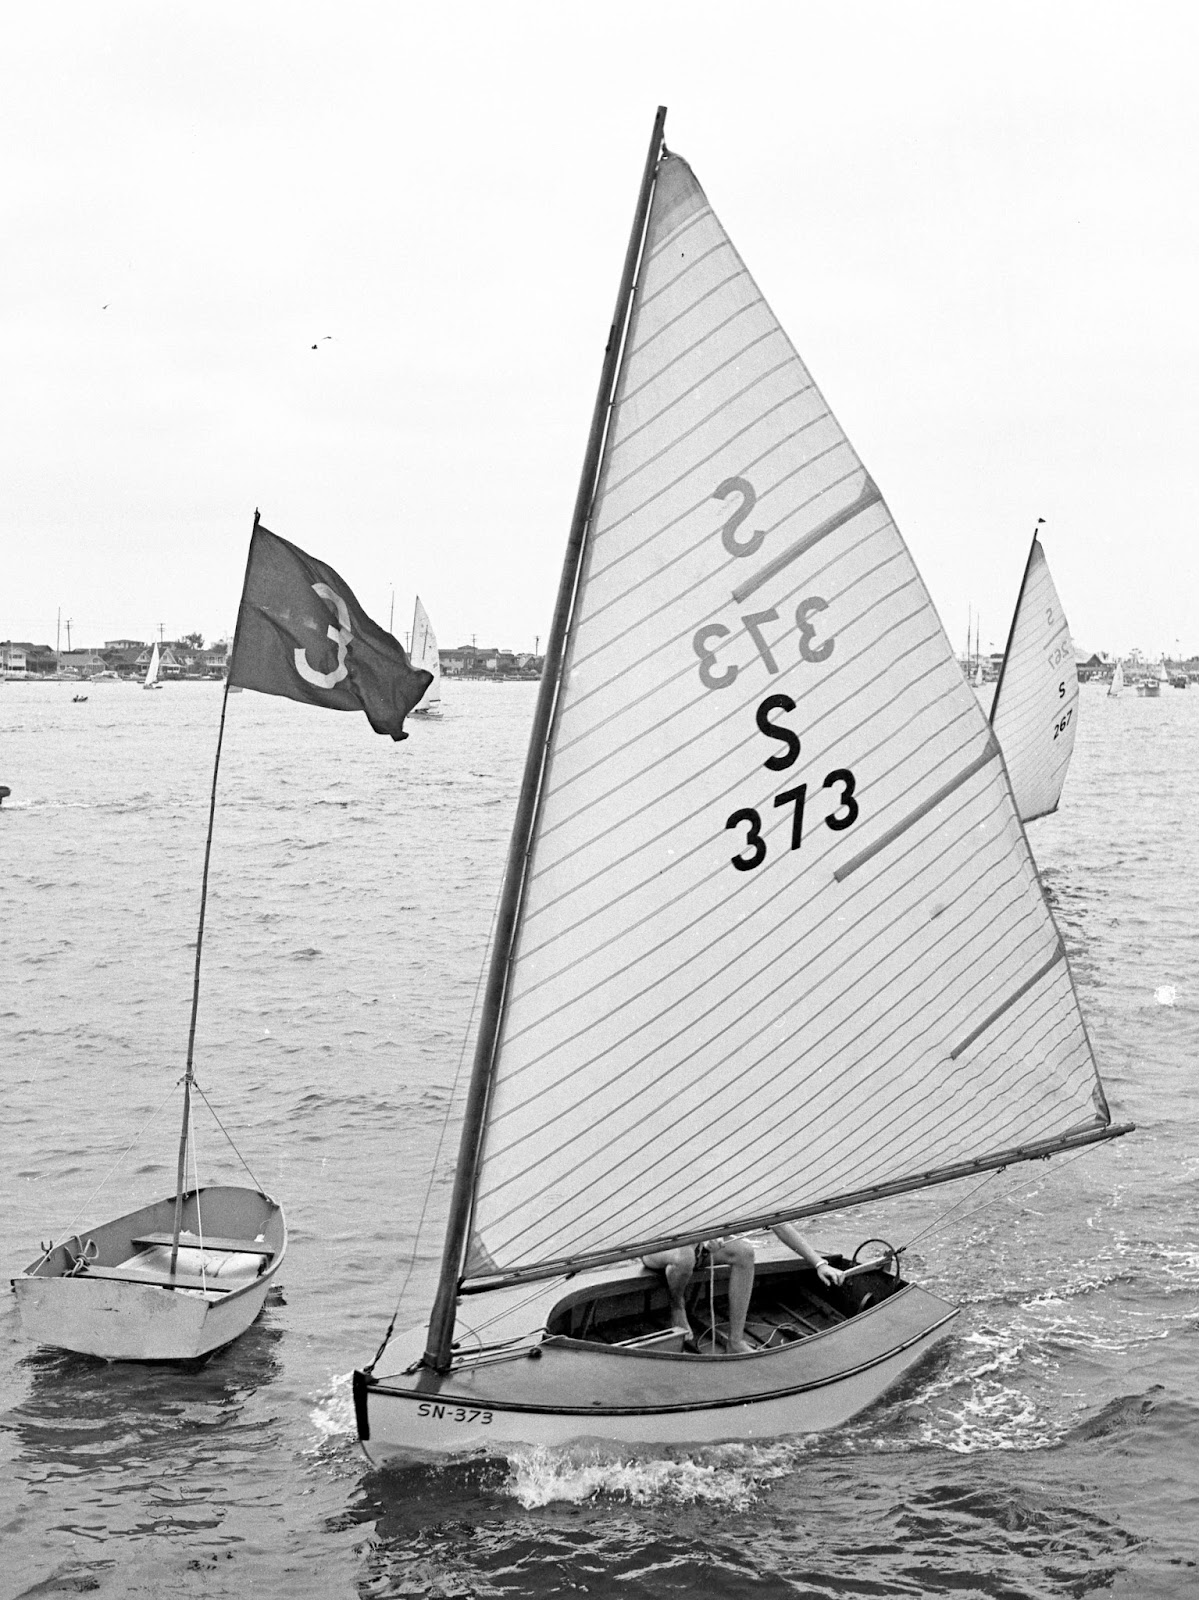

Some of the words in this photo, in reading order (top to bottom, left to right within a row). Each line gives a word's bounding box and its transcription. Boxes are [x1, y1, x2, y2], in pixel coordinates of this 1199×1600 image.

[1059, 681, 1066, 698] S
[756, 694, 800, 771] S
[1053, 708, 1073, 740] 267
[725, 768, 858, 871] 373
[417, 1403, 493, 1424] SN-373
